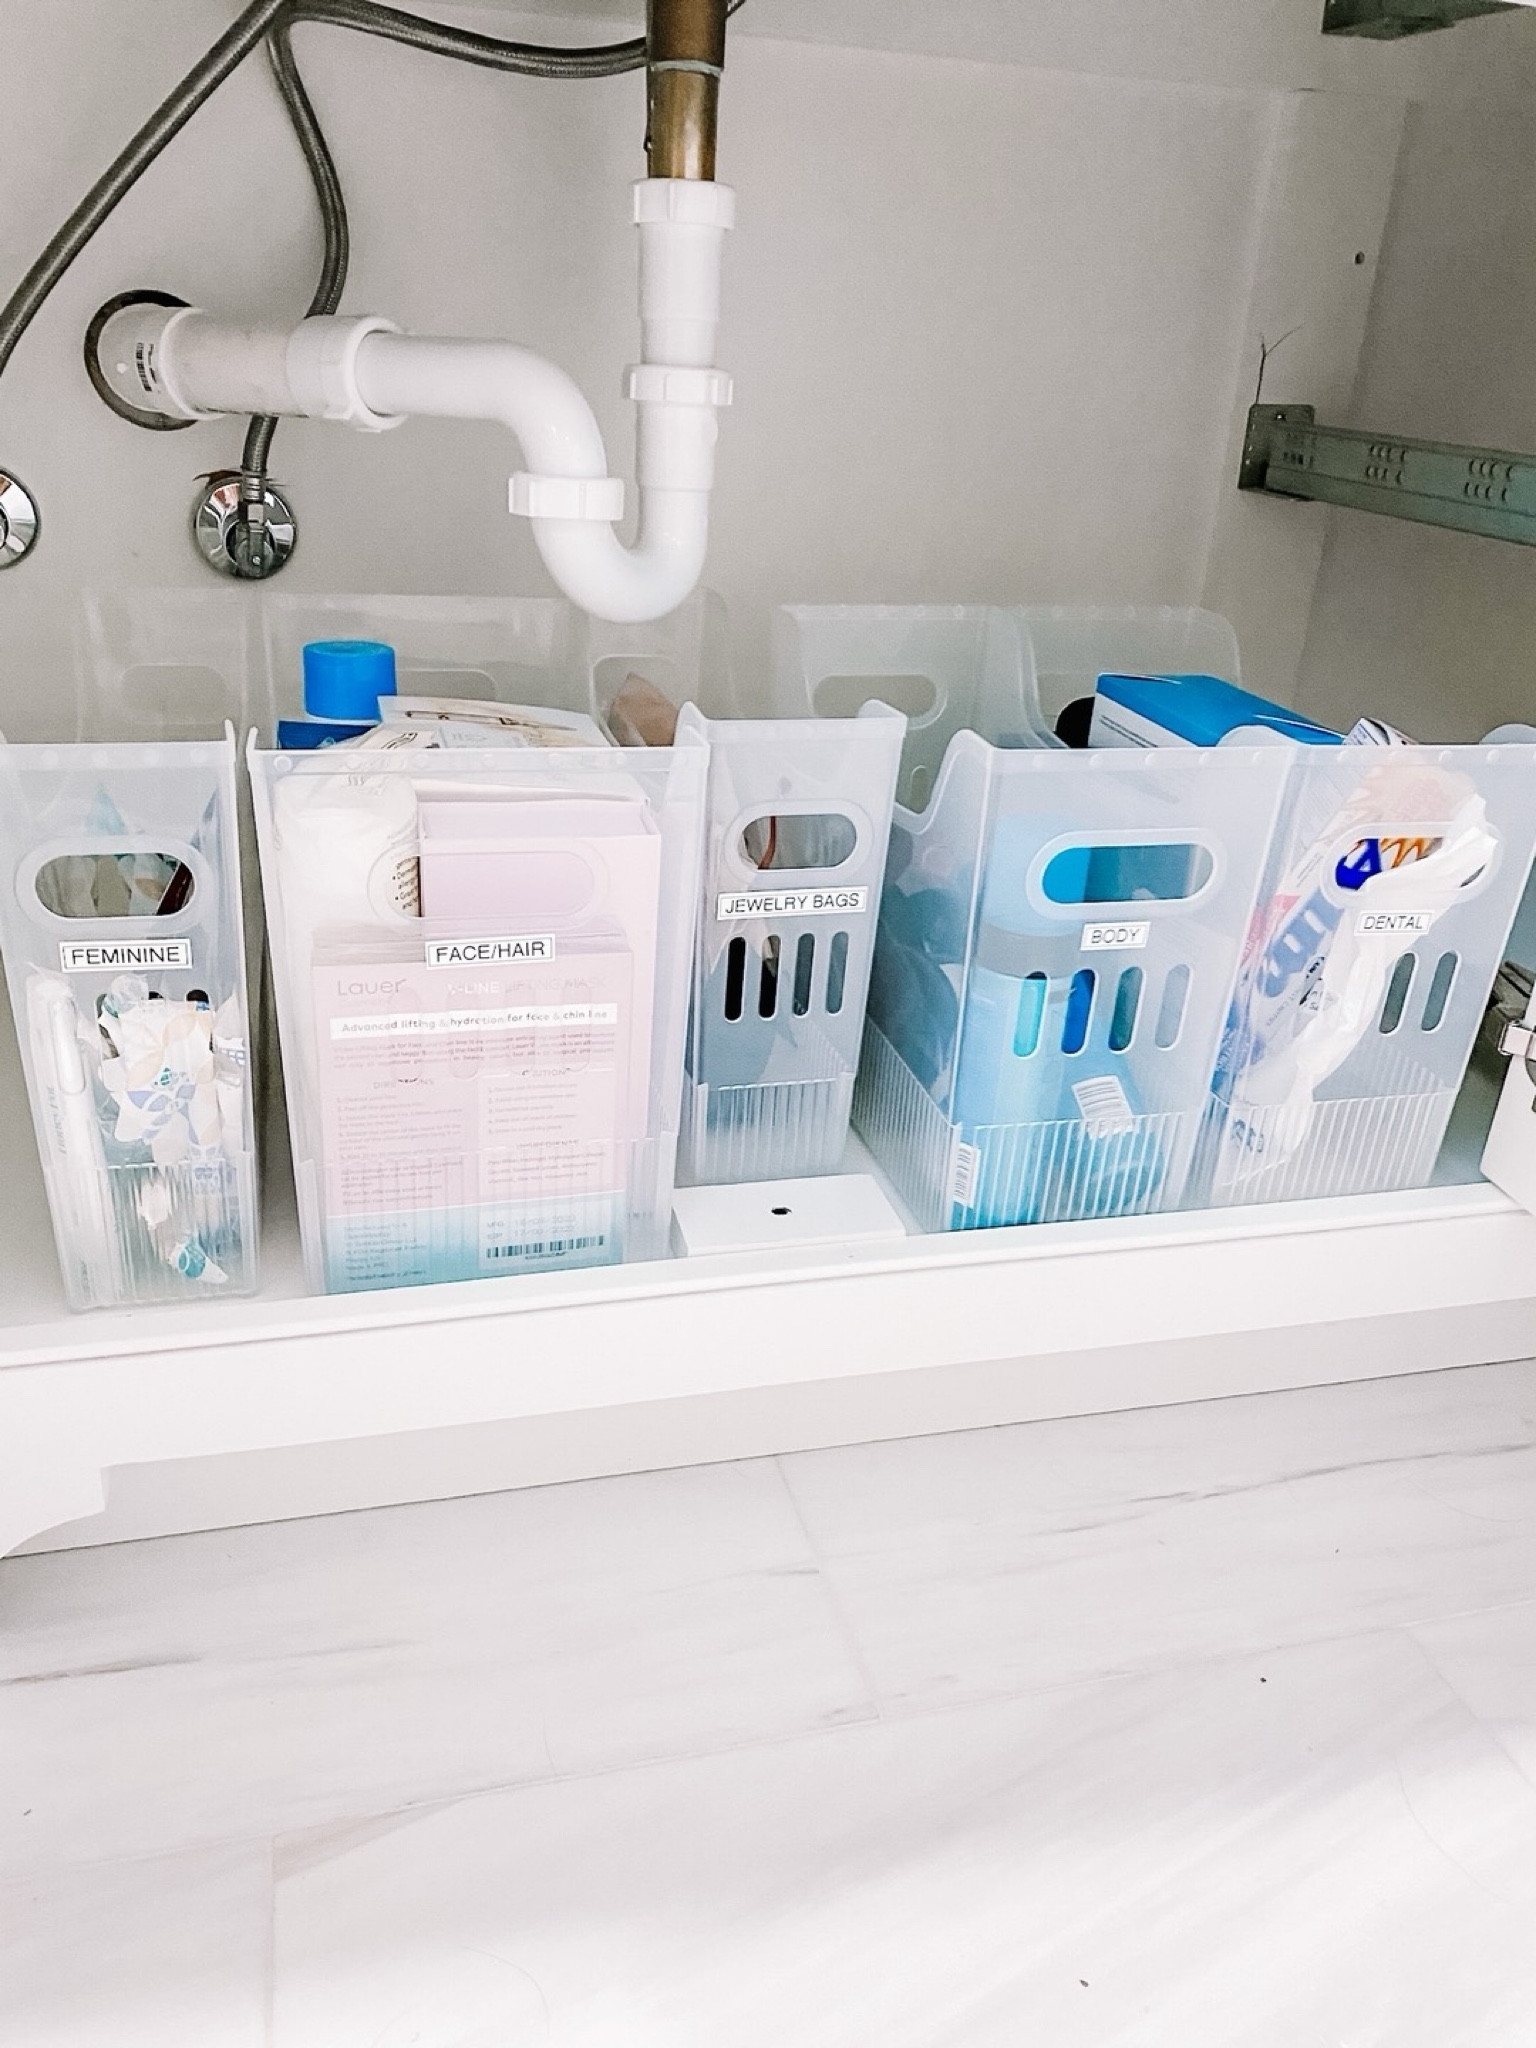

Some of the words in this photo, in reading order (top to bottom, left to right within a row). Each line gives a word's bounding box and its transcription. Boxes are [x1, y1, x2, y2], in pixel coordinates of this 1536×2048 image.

[725, 896, 808, 914] JEWELRY
[812, 892, 860, 909] BAGS
[1363, 915, 1423, 930] DENTAL
[1091, 928, 1142, 944] BODY
[71, 946, 180, 965] FEMININE
[436, 941, 545, 962] FACE/HAIR
[342, 1020, 398, 1033] Advanced
[400, 1018, 436, 1031] lifting
[507, 1013, 523, 1023] for
[562, 1009, 586, 1020] chin
